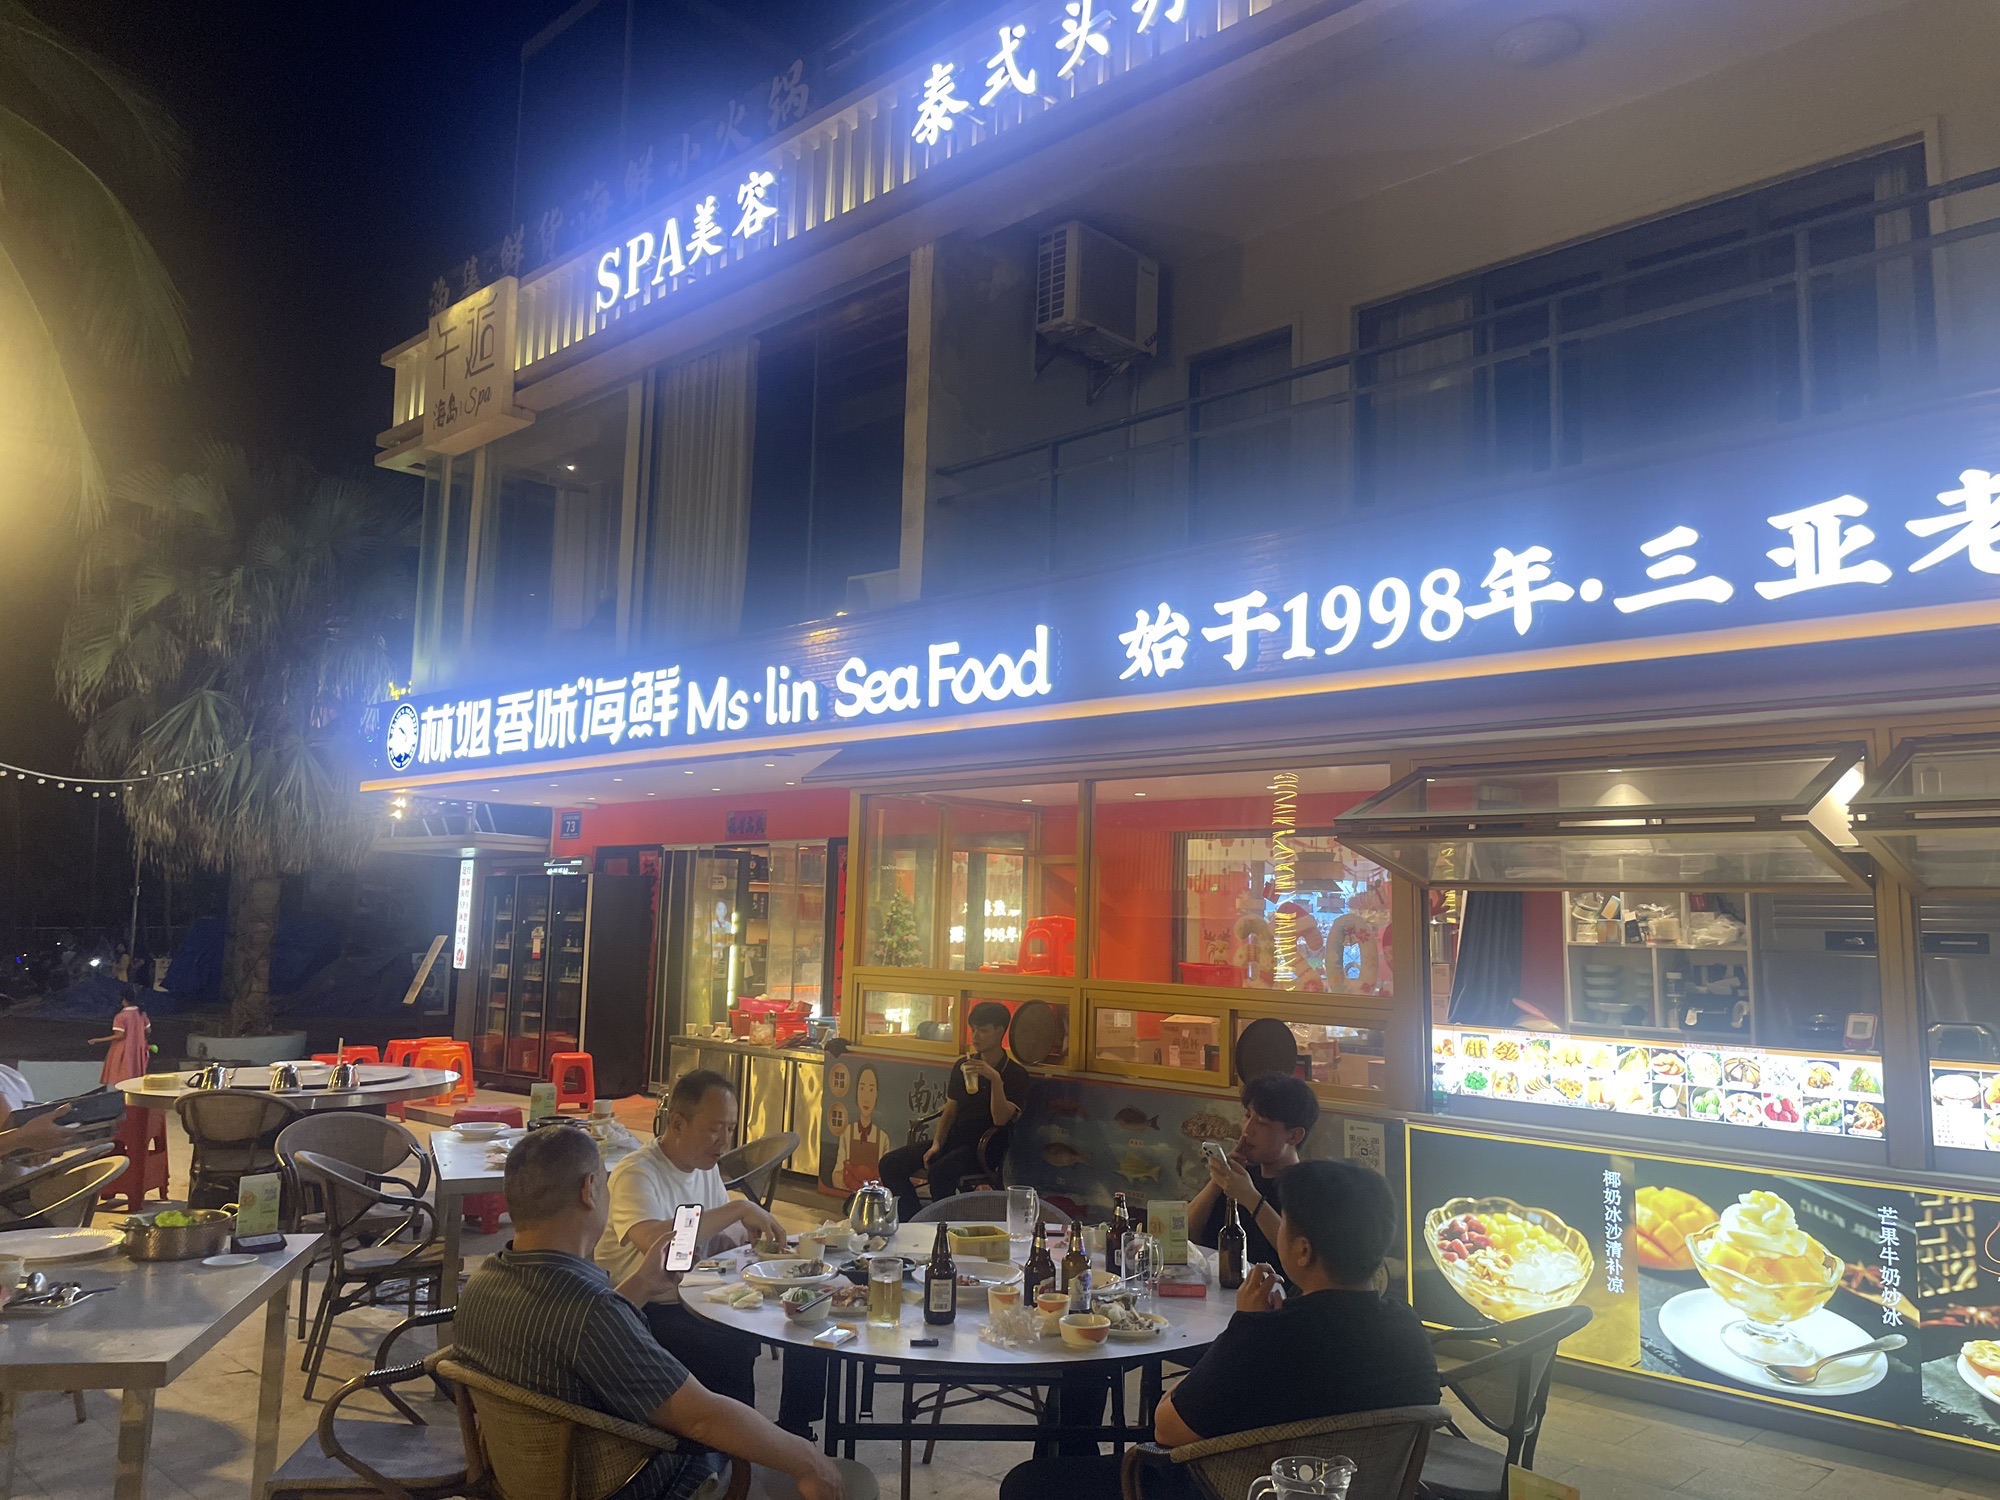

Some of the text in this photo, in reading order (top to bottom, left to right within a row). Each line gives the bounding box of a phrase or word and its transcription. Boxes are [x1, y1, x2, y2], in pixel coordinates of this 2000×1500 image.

[596, 171, 778, 313] SPA美容
[464, 386, 492, 417] Spa
[419, 664, 681, 764] 林姐香味海鲜
[565, 821, 576, 833] 73
[1602, 1169, 1625, 1294] 椰奶冰沙清补凉
[1877, 1205, 1904, 1327] 芒果牛奶炒冰
